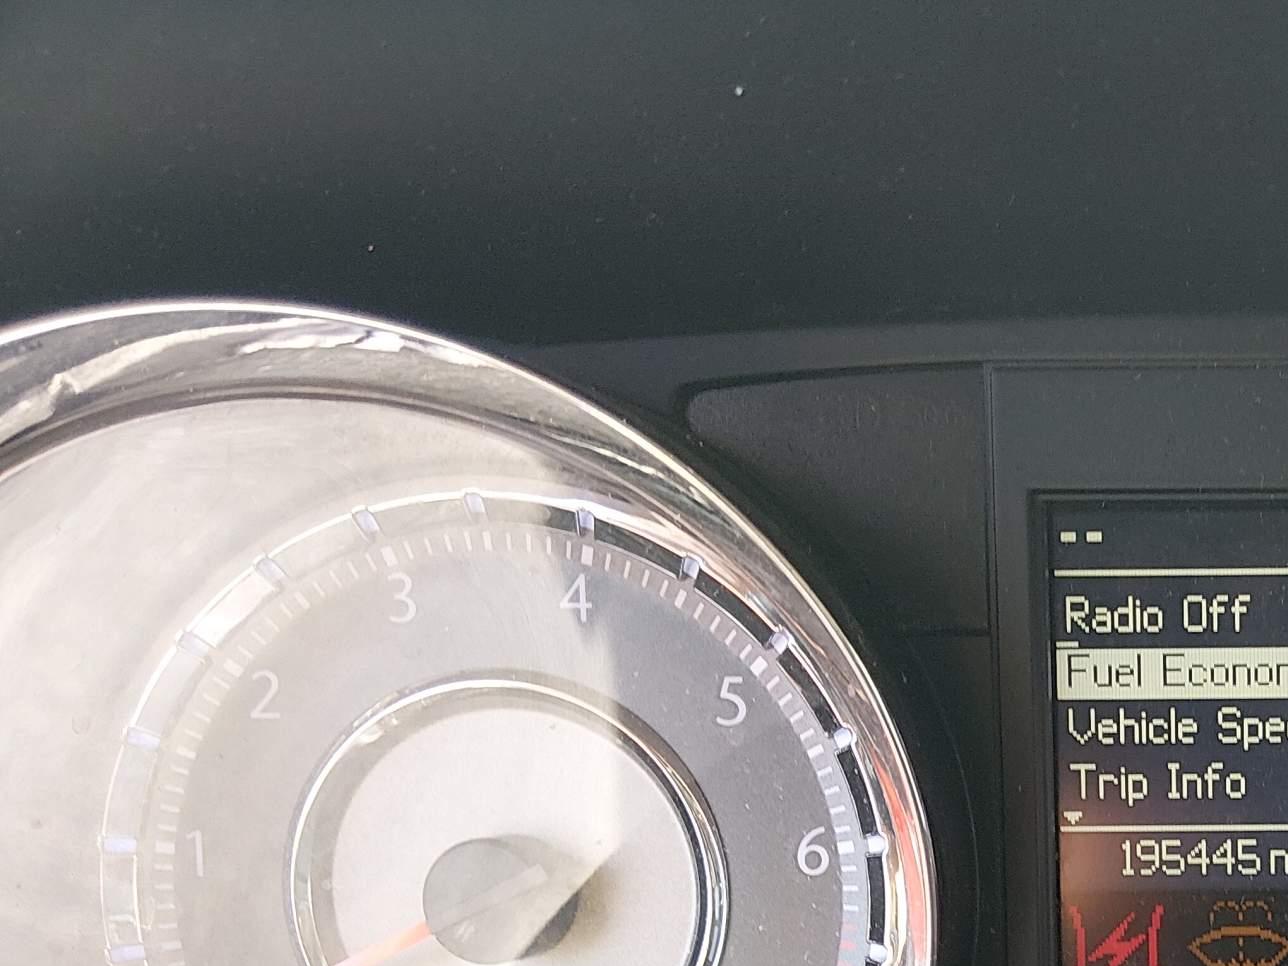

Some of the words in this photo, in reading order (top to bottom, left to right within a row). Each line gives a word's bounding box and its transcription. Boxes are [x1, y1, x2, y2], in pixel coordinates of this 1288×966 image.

[390, 574, 416, 623] 3
[560, 574, 592, 622] 4
[1065, 595, 1163, 634] Radio
[1183, 594, 1251, 633] Off
[1066, 654, 1142, 688] Fuel
[251, 671, 280, 720] 2
[717, 676, 748, 726] 5
[1067, 707, 1198, 745] Vehicle
[1070, 763, 1147, 807] Trip
[1168, 762, 1246, 799] Info
[185, 830, 203, 877] 1
[796, 828, 828, 876] 6
[1121, 839, 1261, 876] 195445
